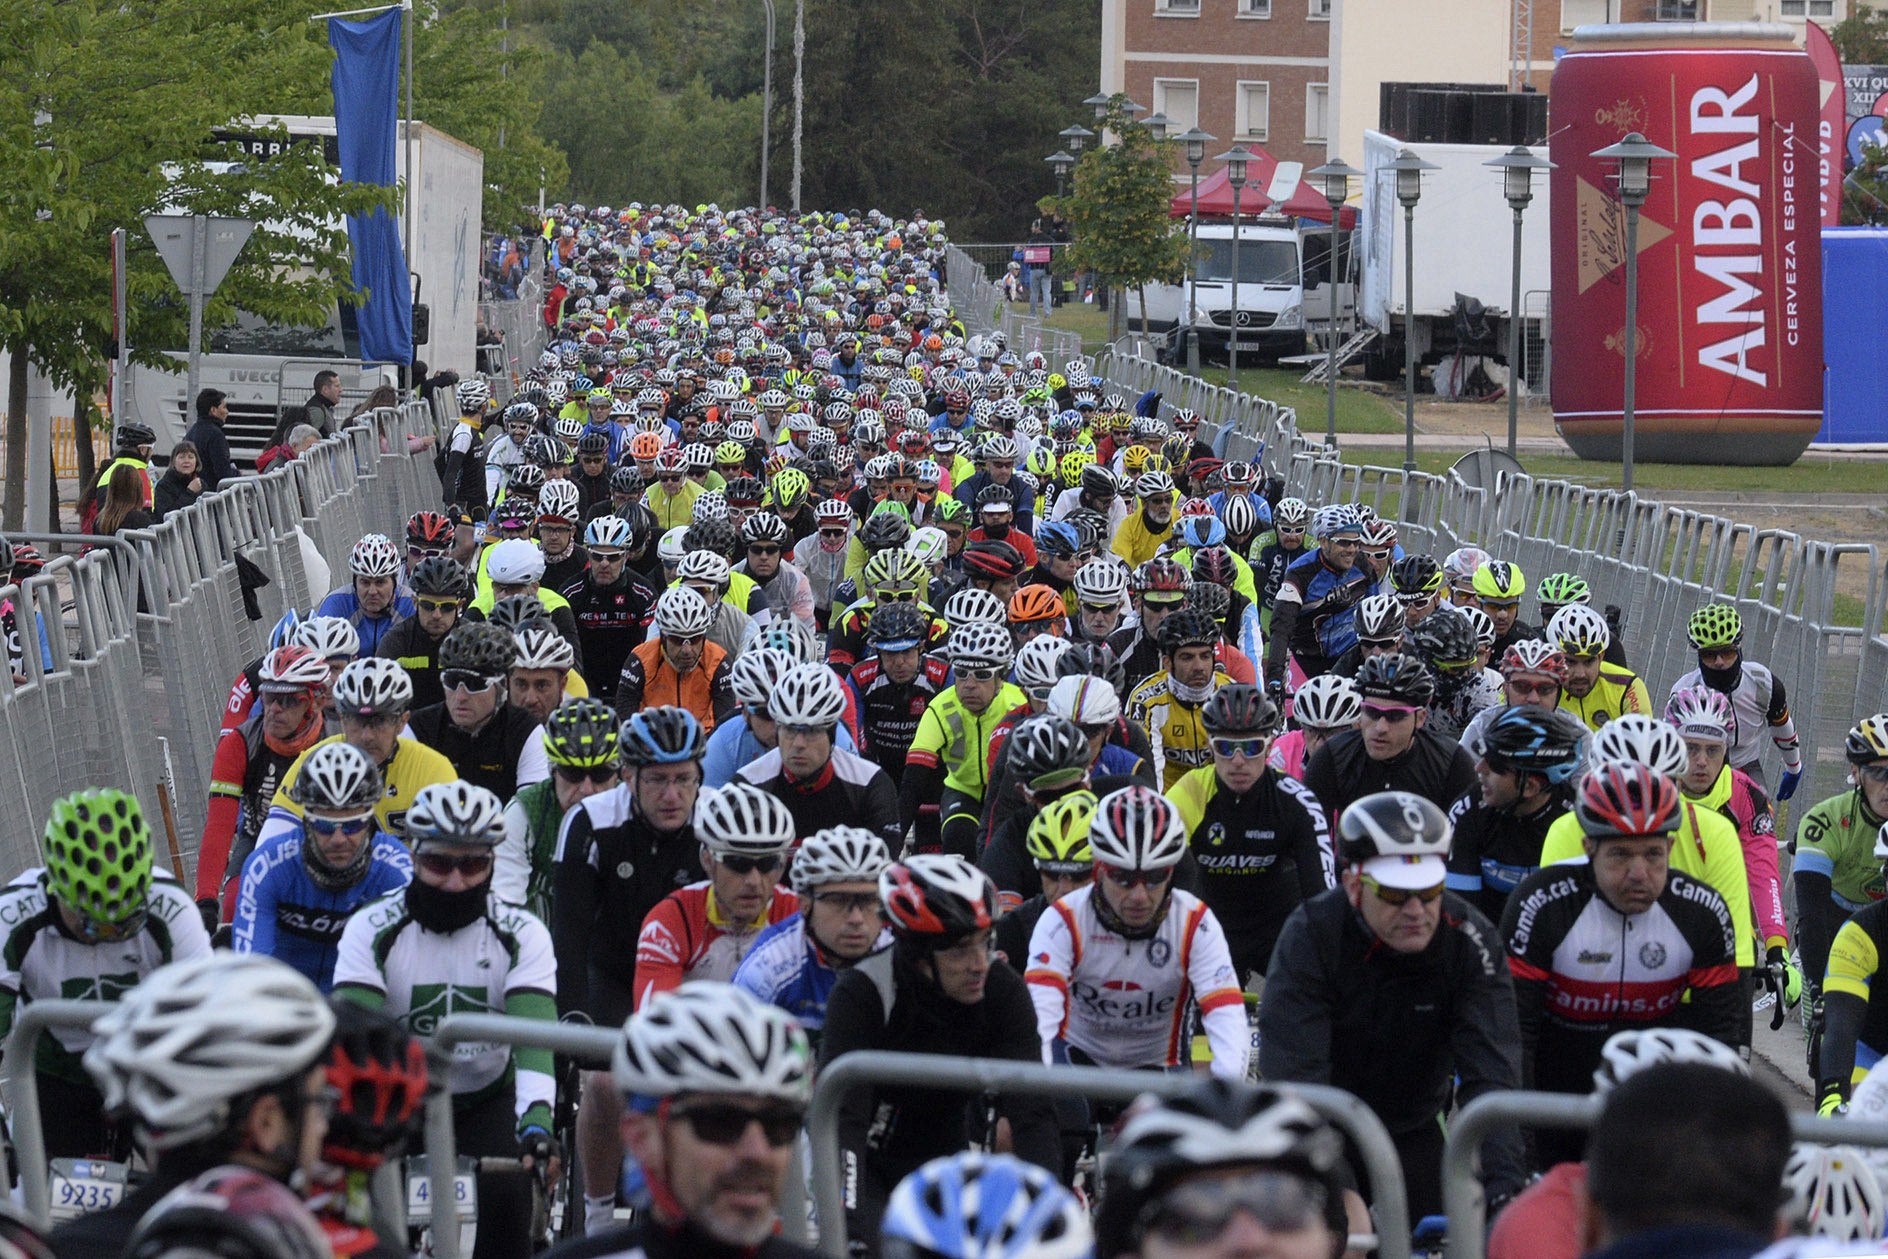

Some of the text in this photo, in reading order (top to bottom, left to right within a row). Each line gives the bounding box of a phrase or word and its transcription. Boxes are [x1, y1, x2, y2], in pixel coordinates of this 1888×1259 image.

[1581, 201, 1589, 267] ORIGINAL
[1690, 73, 1767, 388] AMBAR
[1783, 121, 1799, 346] CERVEZA ESPECIAL
[1196, 853, 1277, 868] SUAVES
[1276, 776, 1338, 891] SUAVES
[1509, 877, 1579, 957] Camins.cat
[1072, 981, 1175, 1019] Reale
[61, 1183, 113, 1211] 9235
